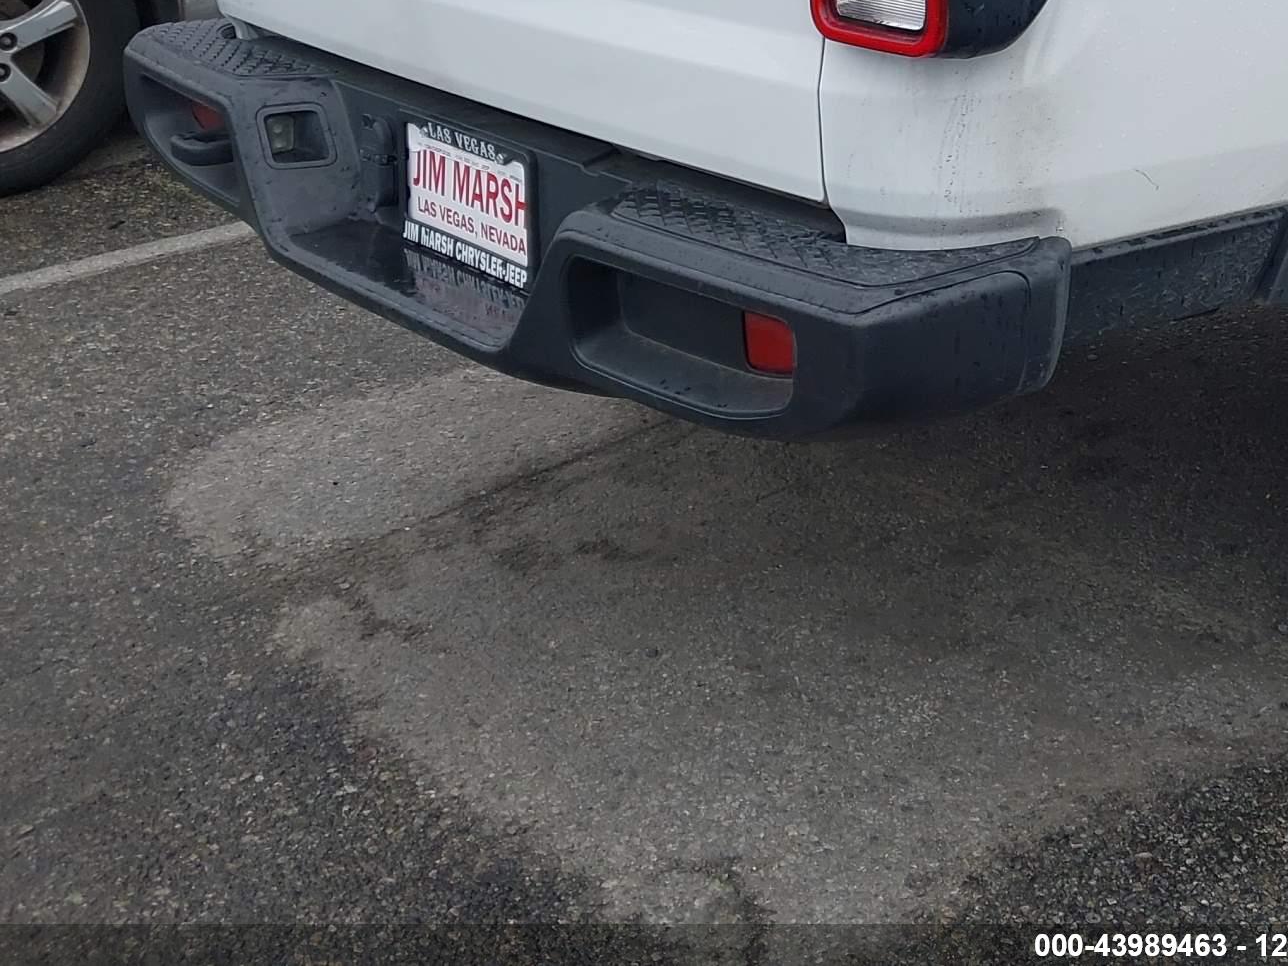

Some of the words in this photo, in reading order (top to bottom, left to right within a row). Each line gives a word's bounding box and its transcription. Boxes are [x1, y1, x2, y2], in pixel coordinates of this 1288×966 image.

[428, 121, 452, 144] LAS
[454, 131, 496, 161] VEGAS
[413, 148, 446, 197] JIM
[453, 160, 528, 227] MARSH
[402, 219, 419, 244] JIM
[420, 226, 454, 258] MARSH
[417, 195, 437, 219] LAS
[439, 205, 479, 240] VEGAS,
[480, 221, 526, 256] NEVADA
